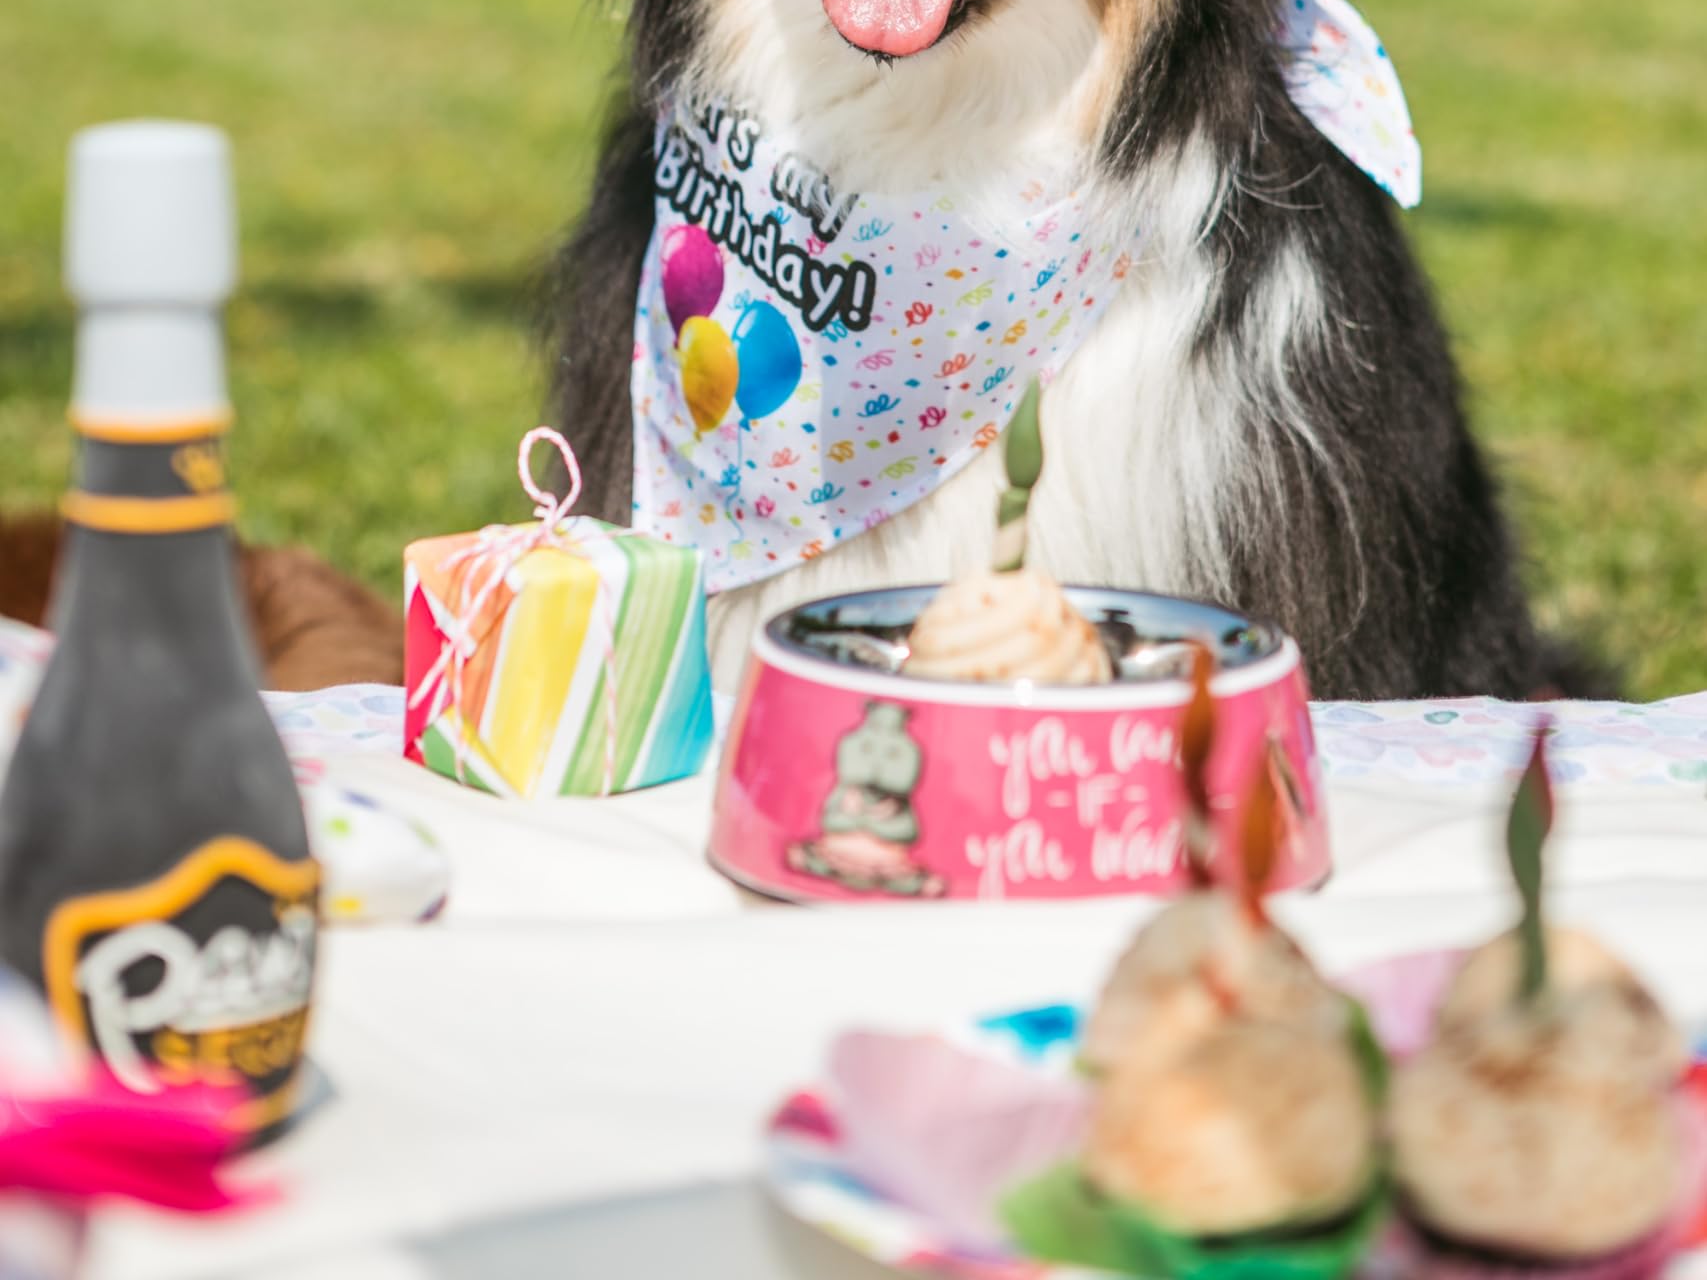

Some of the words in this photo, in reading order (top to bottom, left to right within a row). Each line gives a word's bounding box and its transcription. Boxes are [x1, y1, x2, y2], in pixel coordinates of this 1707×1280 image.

[652, 123, 877, 332] Birthday!
[988, 715, 1097, 819] you
[965, 818, 1074, 898] you
